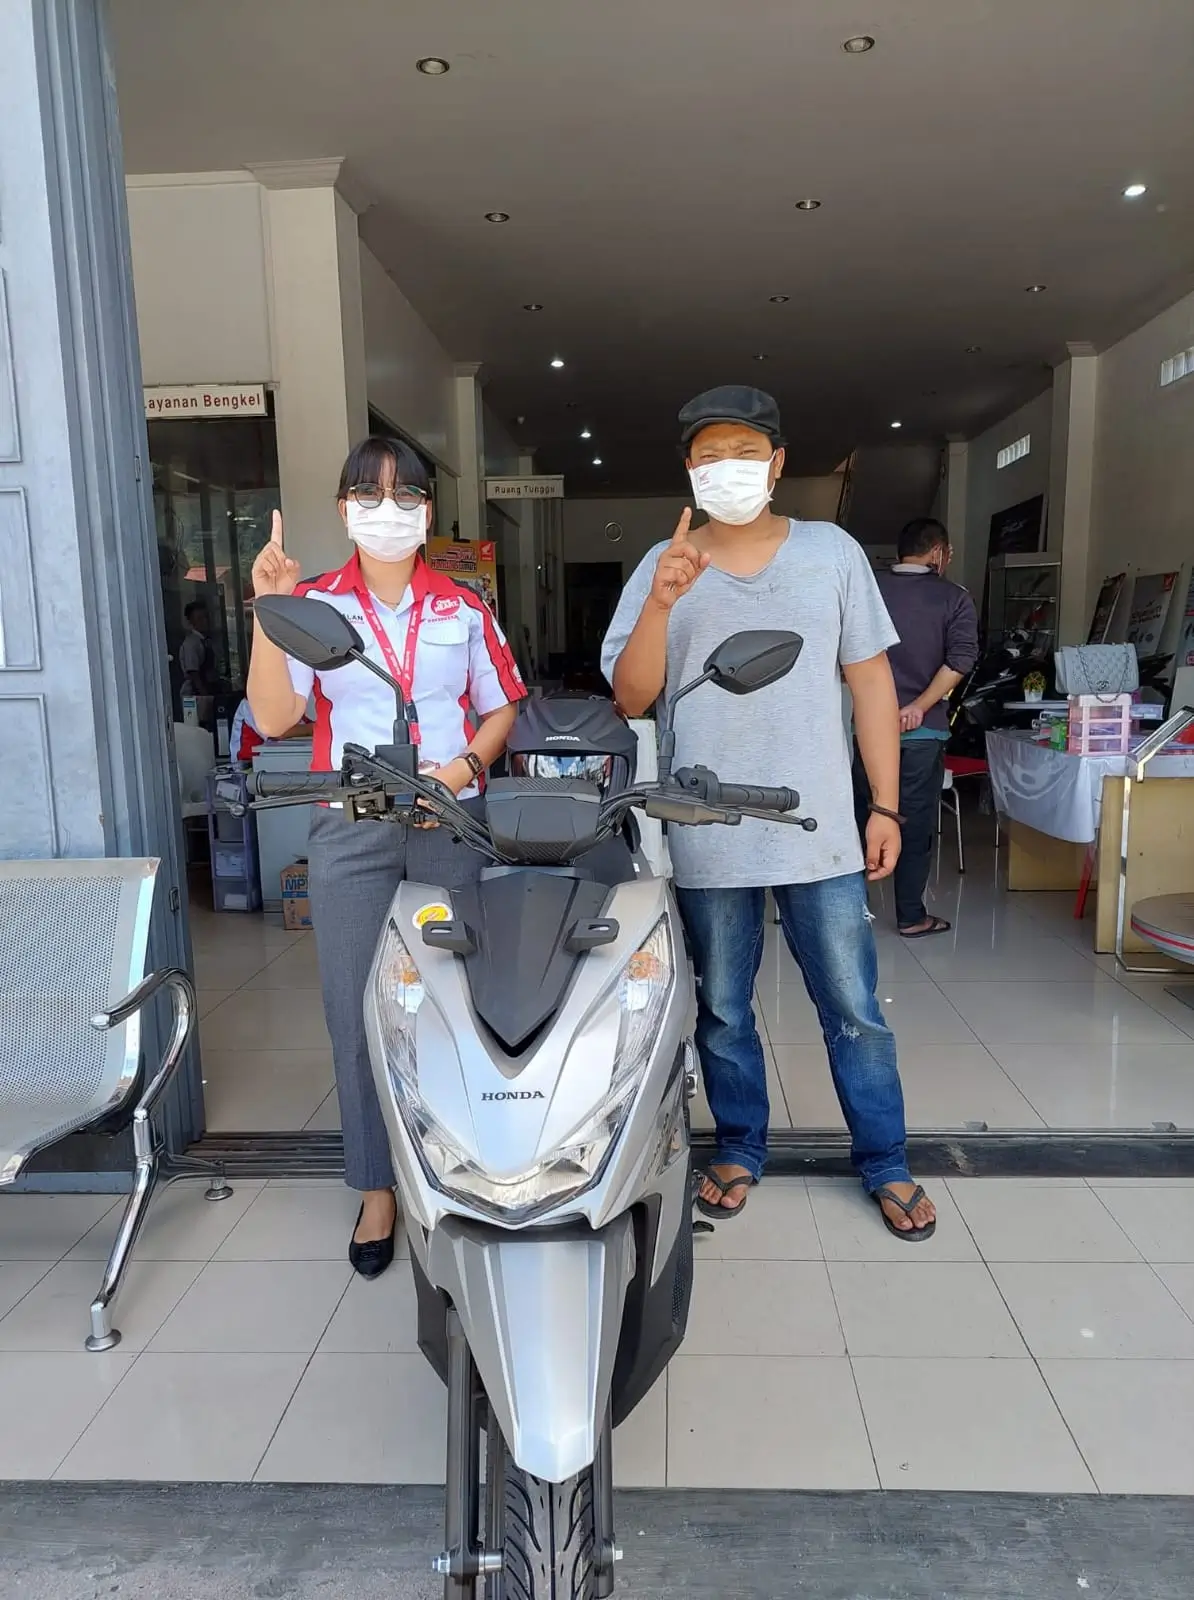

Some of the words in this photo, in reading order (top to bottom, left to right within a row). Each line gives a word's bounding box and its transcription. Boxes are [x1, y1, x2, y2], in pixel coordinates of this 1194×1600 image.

[145, 397, 198, 412] ayanan
[203, 393, 260, 409] Bengkel
[481, 1090, 545, 1101] HONDA
